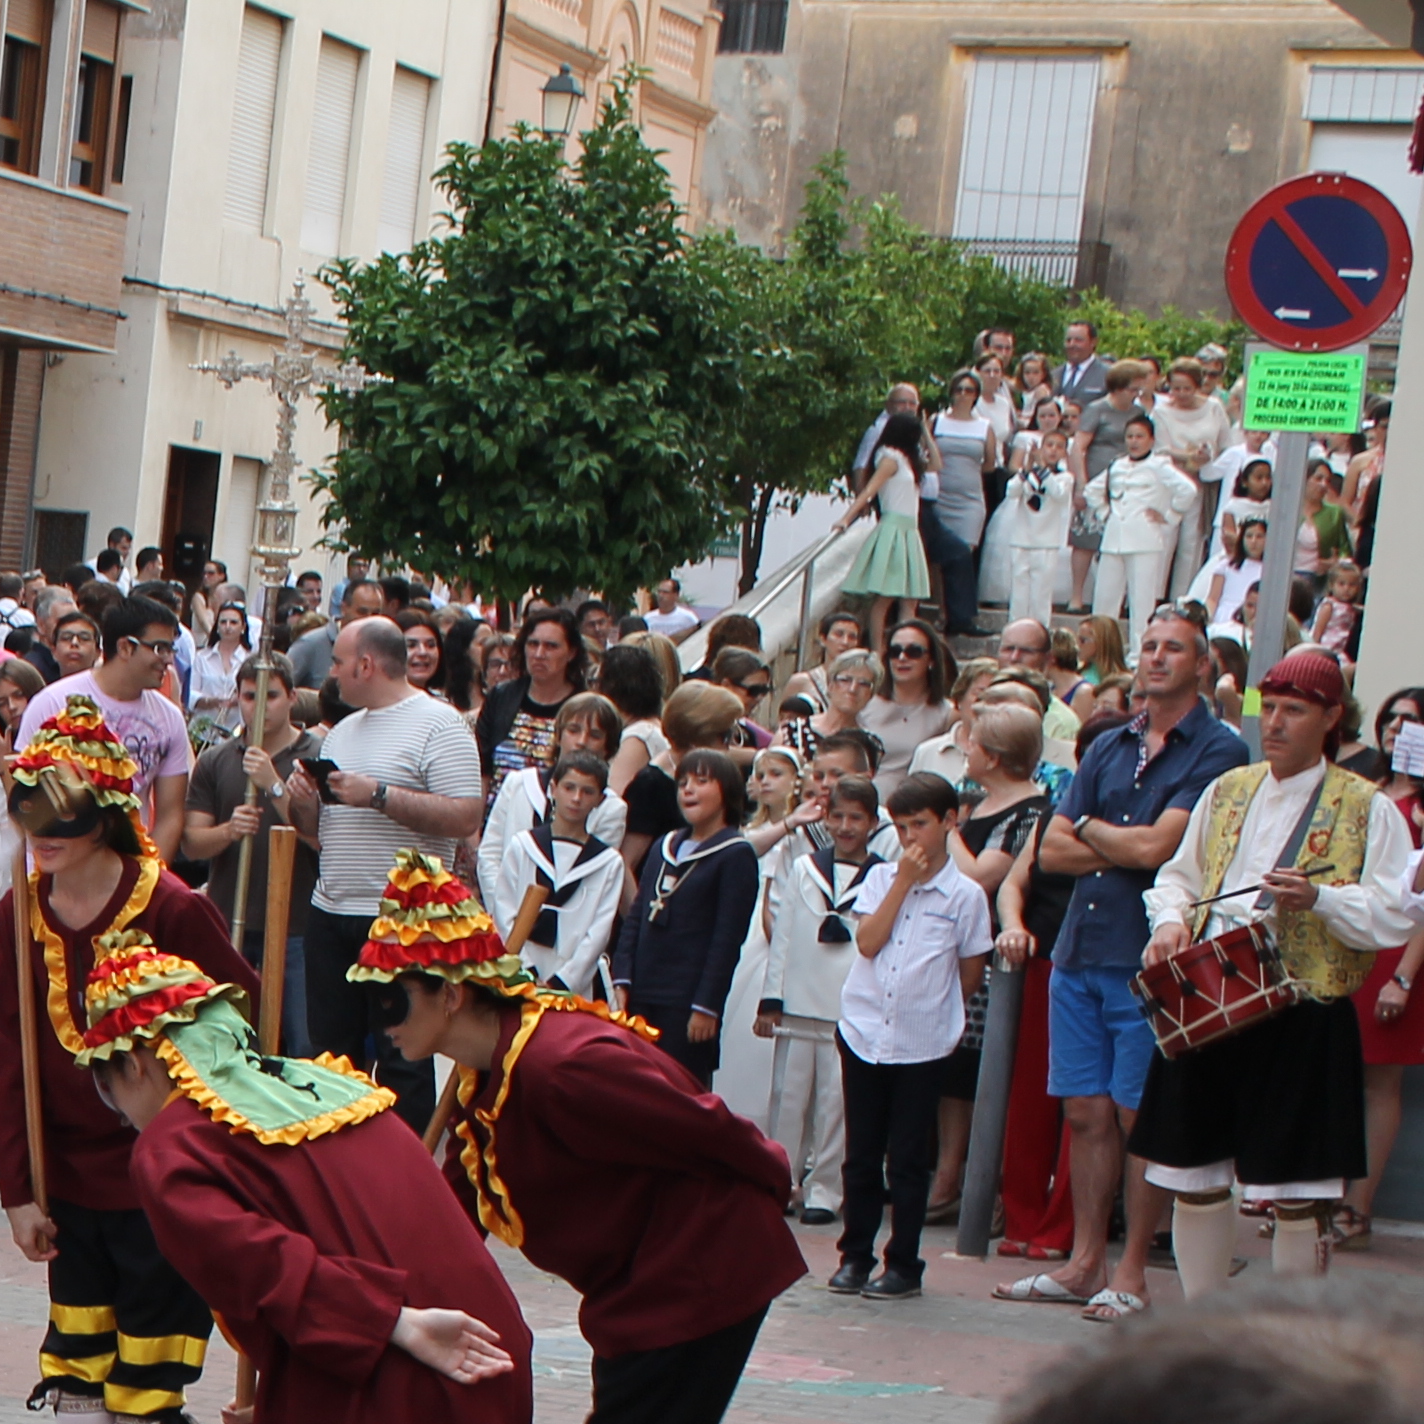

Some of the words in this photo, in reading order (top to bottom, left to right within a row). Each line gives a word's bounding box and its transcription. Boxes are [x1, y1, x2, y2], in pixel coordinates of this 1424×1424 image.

[1266, 368, 1281, 377] NO
[1283, 368, 1346, 378] ESTACIONAR
[1267, 381, 1275, 390] de
[1256, 396, 1270, 409] DE
[1273, 396, 1298, 409] 14:00
[1299, 397, 1306, 410] A
[1310, 398, 1336, 411] 21:00
